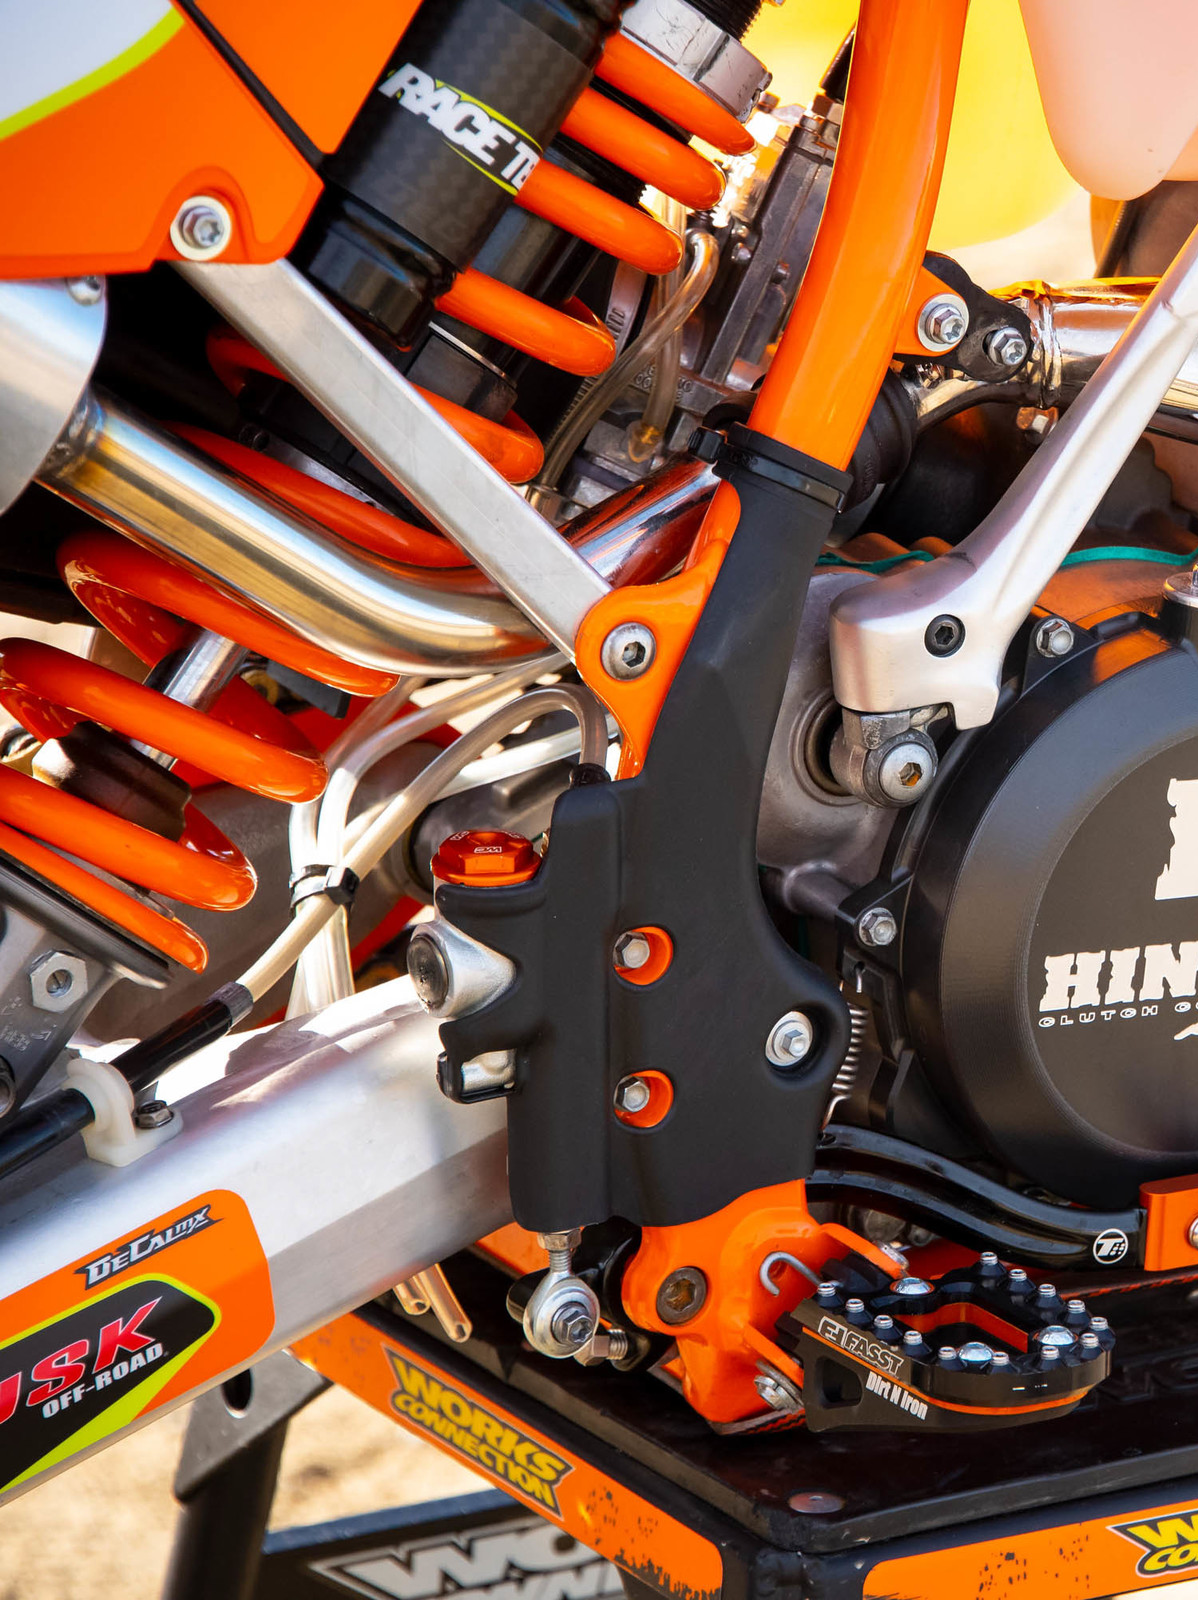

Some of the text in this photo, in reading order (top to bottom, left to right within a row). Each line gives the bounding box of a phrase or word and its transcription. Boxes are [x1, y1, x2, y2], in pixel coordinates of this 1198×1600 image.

[378, 62, 516, 166] RACE
[1038, 1006, 1159, 1028] CLUTCH
[42, 1343, 163, 1419] OFF-ROAD
[844, 1331, 904, 1375] FASST
[393, 1357, 566, 1481] WORKS
[889, 1384, 901, 1405] N
[900, 1390, 928, 1420] Iron
[394, 1394, 556, 1509] CONNECTION
